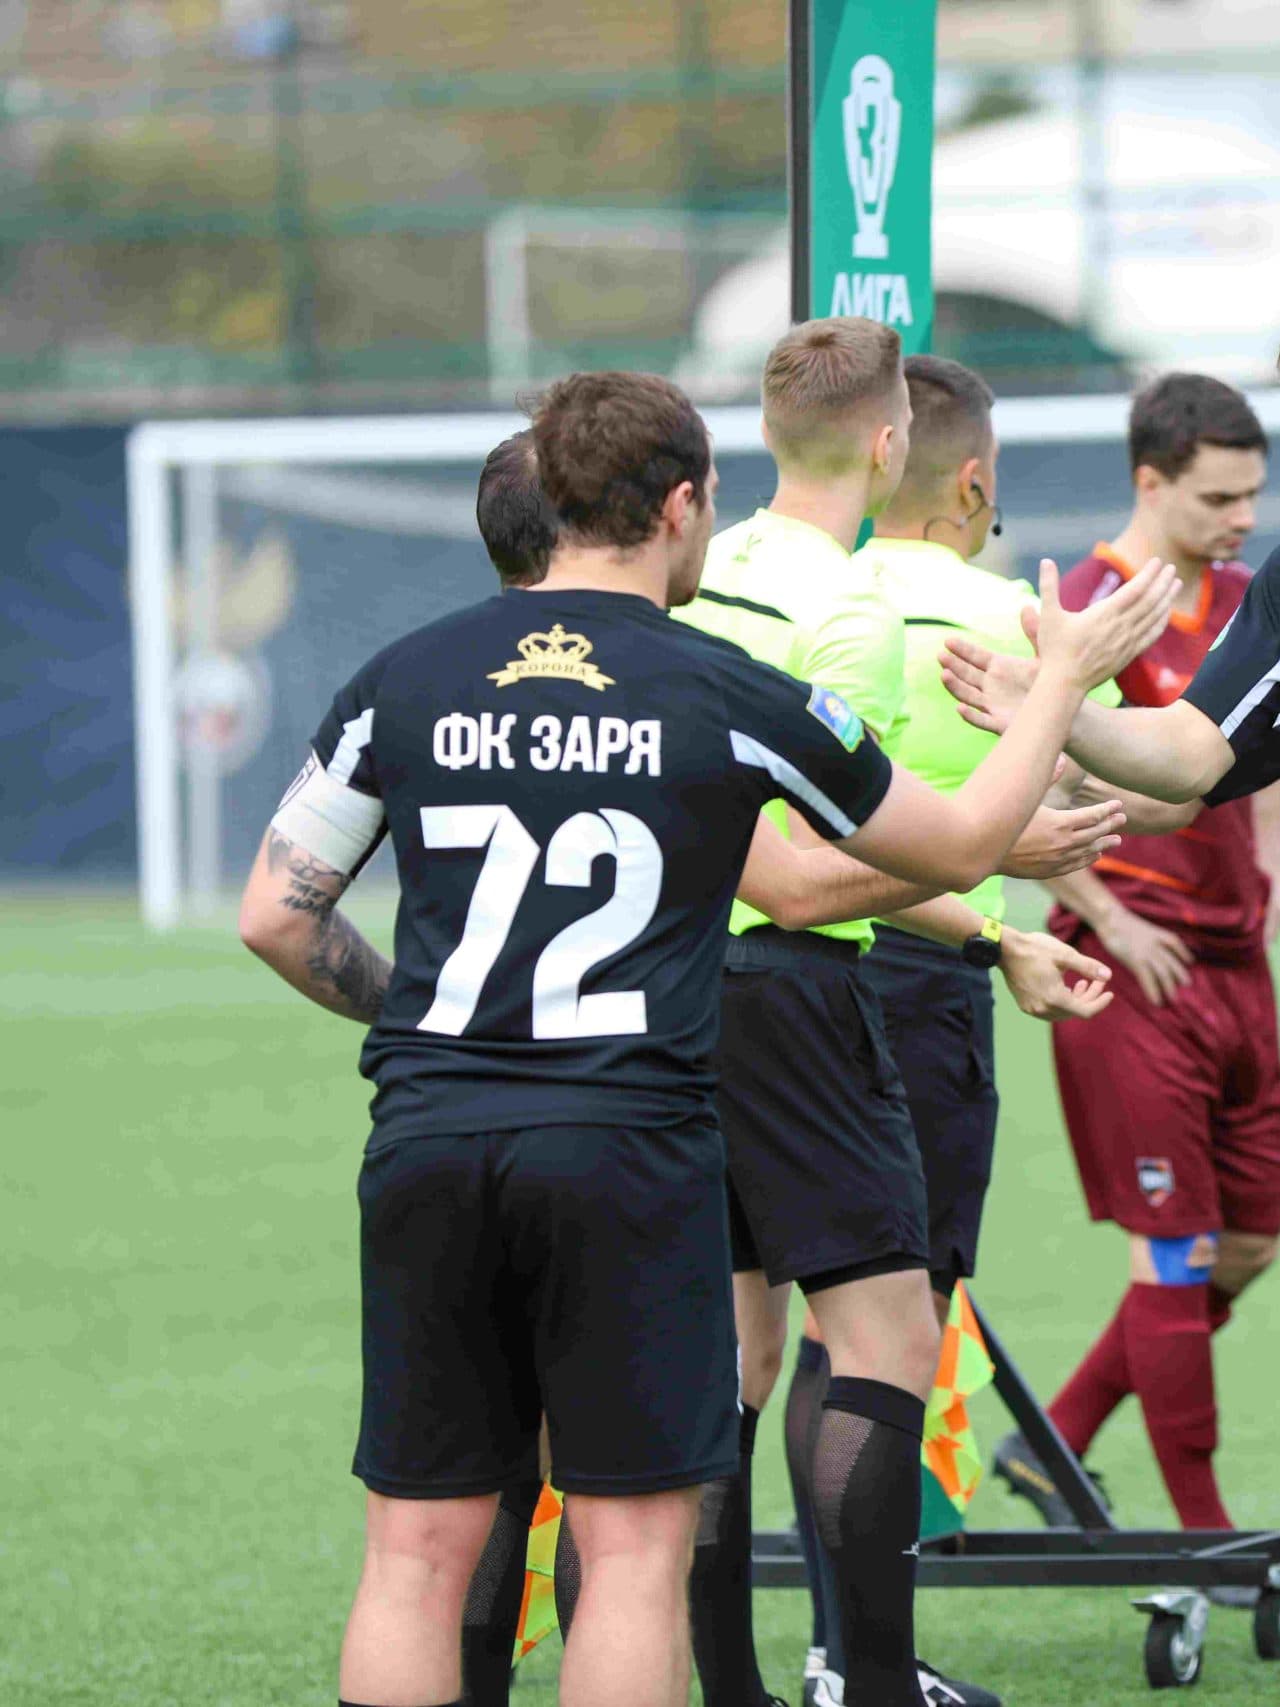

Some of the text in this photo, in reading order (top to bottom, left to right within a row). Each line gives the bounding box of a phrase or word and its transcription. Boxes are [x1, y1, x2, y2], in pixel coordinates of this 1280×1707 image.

[830, 271, 913, 326] ЛИГА
[515, 663, 586, 677] КОРОНА
[433, 712, 662, 776] ФК ЗАРЯ
[416, 805, 663, 1040] 72
